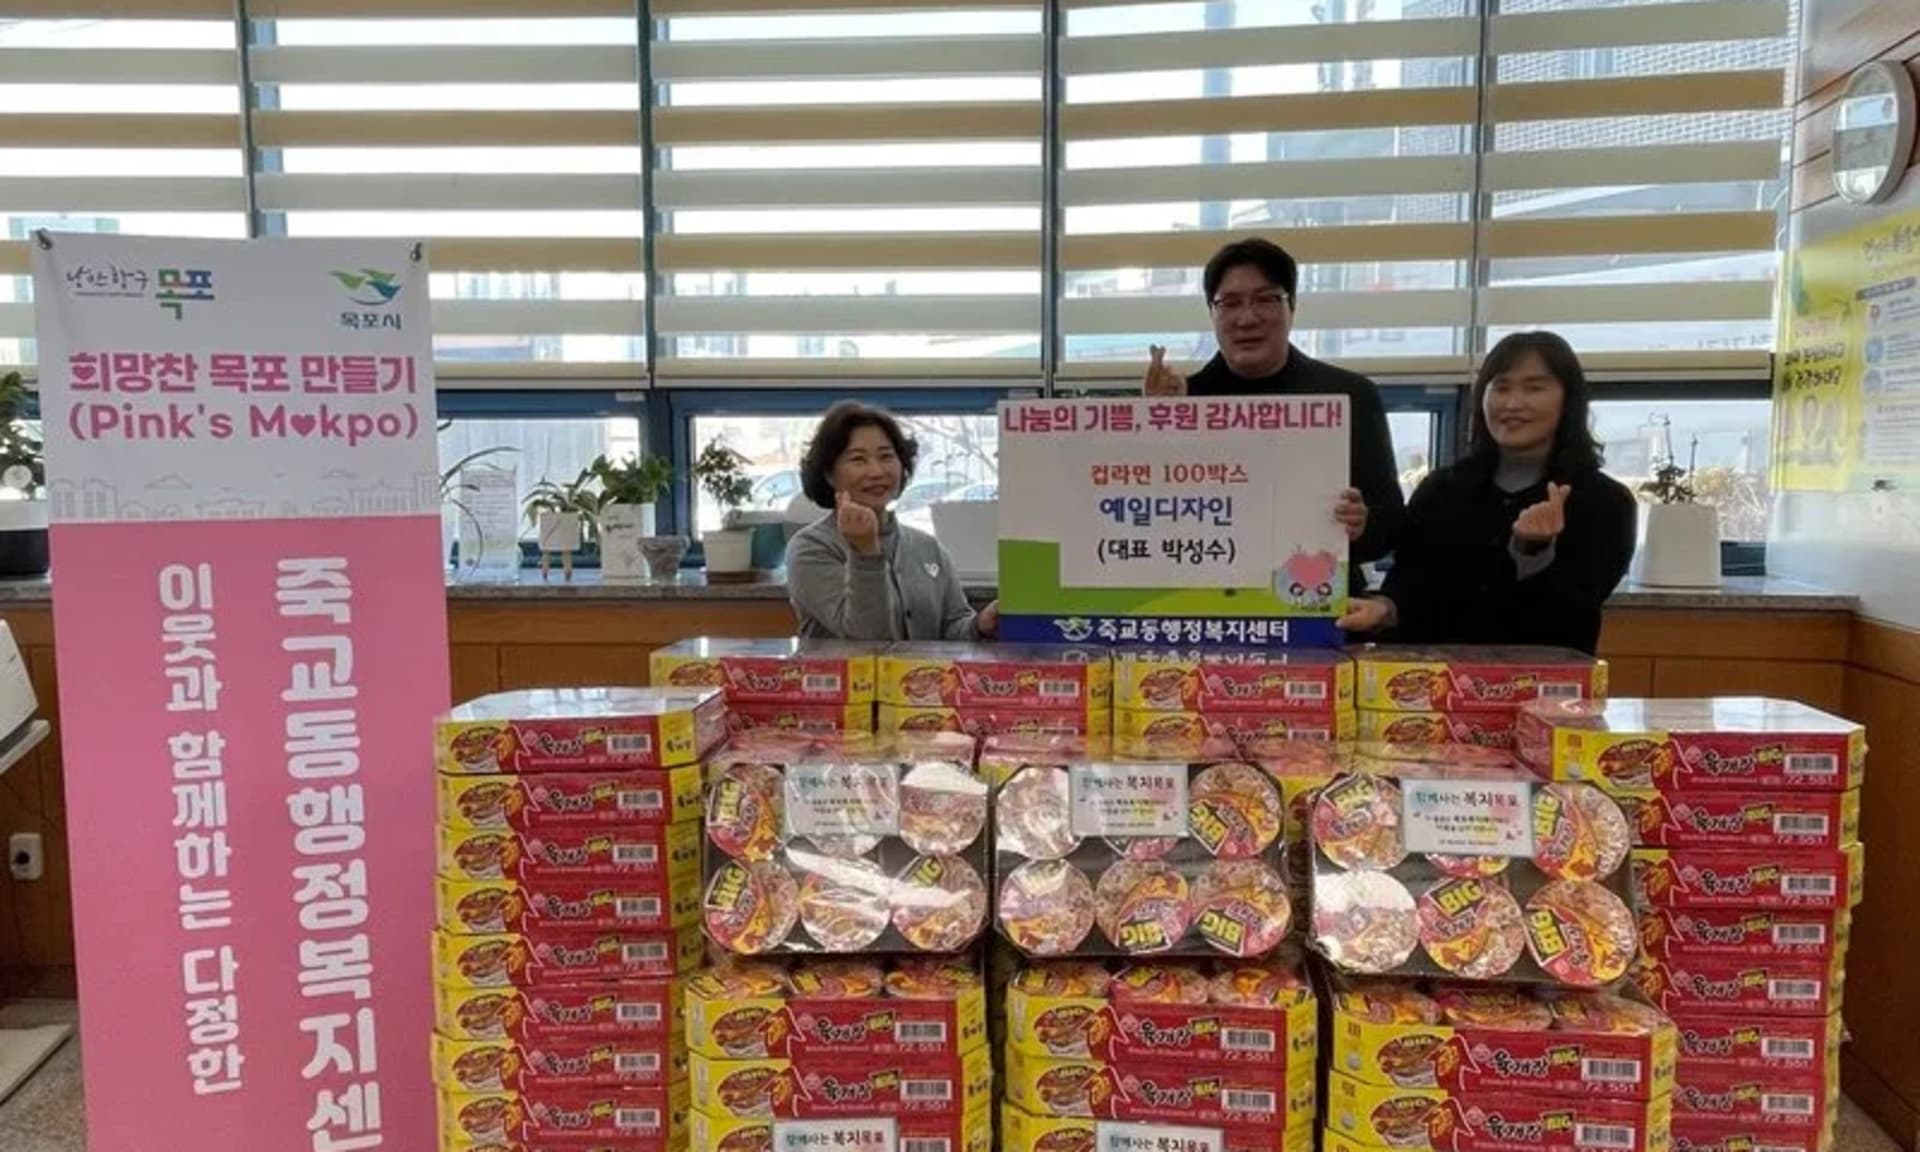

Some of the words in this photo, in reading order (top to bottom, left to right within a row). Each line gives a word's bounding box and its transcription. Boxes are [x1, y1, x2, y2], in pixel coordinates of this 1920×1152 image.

[155, 267, 215, 321] 목포
[341, 312, 401, 330] 목포시
[69, 352, 197, 393] 희망찬
[210, 354, 290, 394] 목포
[300, 355, 416, 395] 만들기
[69, 402, 233, 441] (Pink's
[1005, 406, 1077, 433] 나눔의
[1084, 405, 1141, 433] 기쁨,
[1149, 404, 1198, 430] 후원
[1207, 402, 1343, 430] 감사합니다!
[1091, 463, 1152, 485] 컵라면
[1163, 463, 1249, 485] 100박스
[1100, 496, 1233, 526] 예일디자인
[1097, 538, 1151, 564] (대표
[1161, 538, 1237, 564] 박성수)
[158, 562, 223, 712] 이웃과
[1098, 618, 1289, 643] 죽교동행정복지센터
[168, 730, 234, 930] 함께하는
[1190, 804, 1226, 843] BIG
[714, 867, 747, 908] BIG
[1436, 879, 1483, 915] BIG
[1119, 922, 1164, 947] BIG
[1201, 909, 1241, 944] BIG
[1530, 909, 1563, 955] BIG
[182, 944, 246, 1096] 다정한
